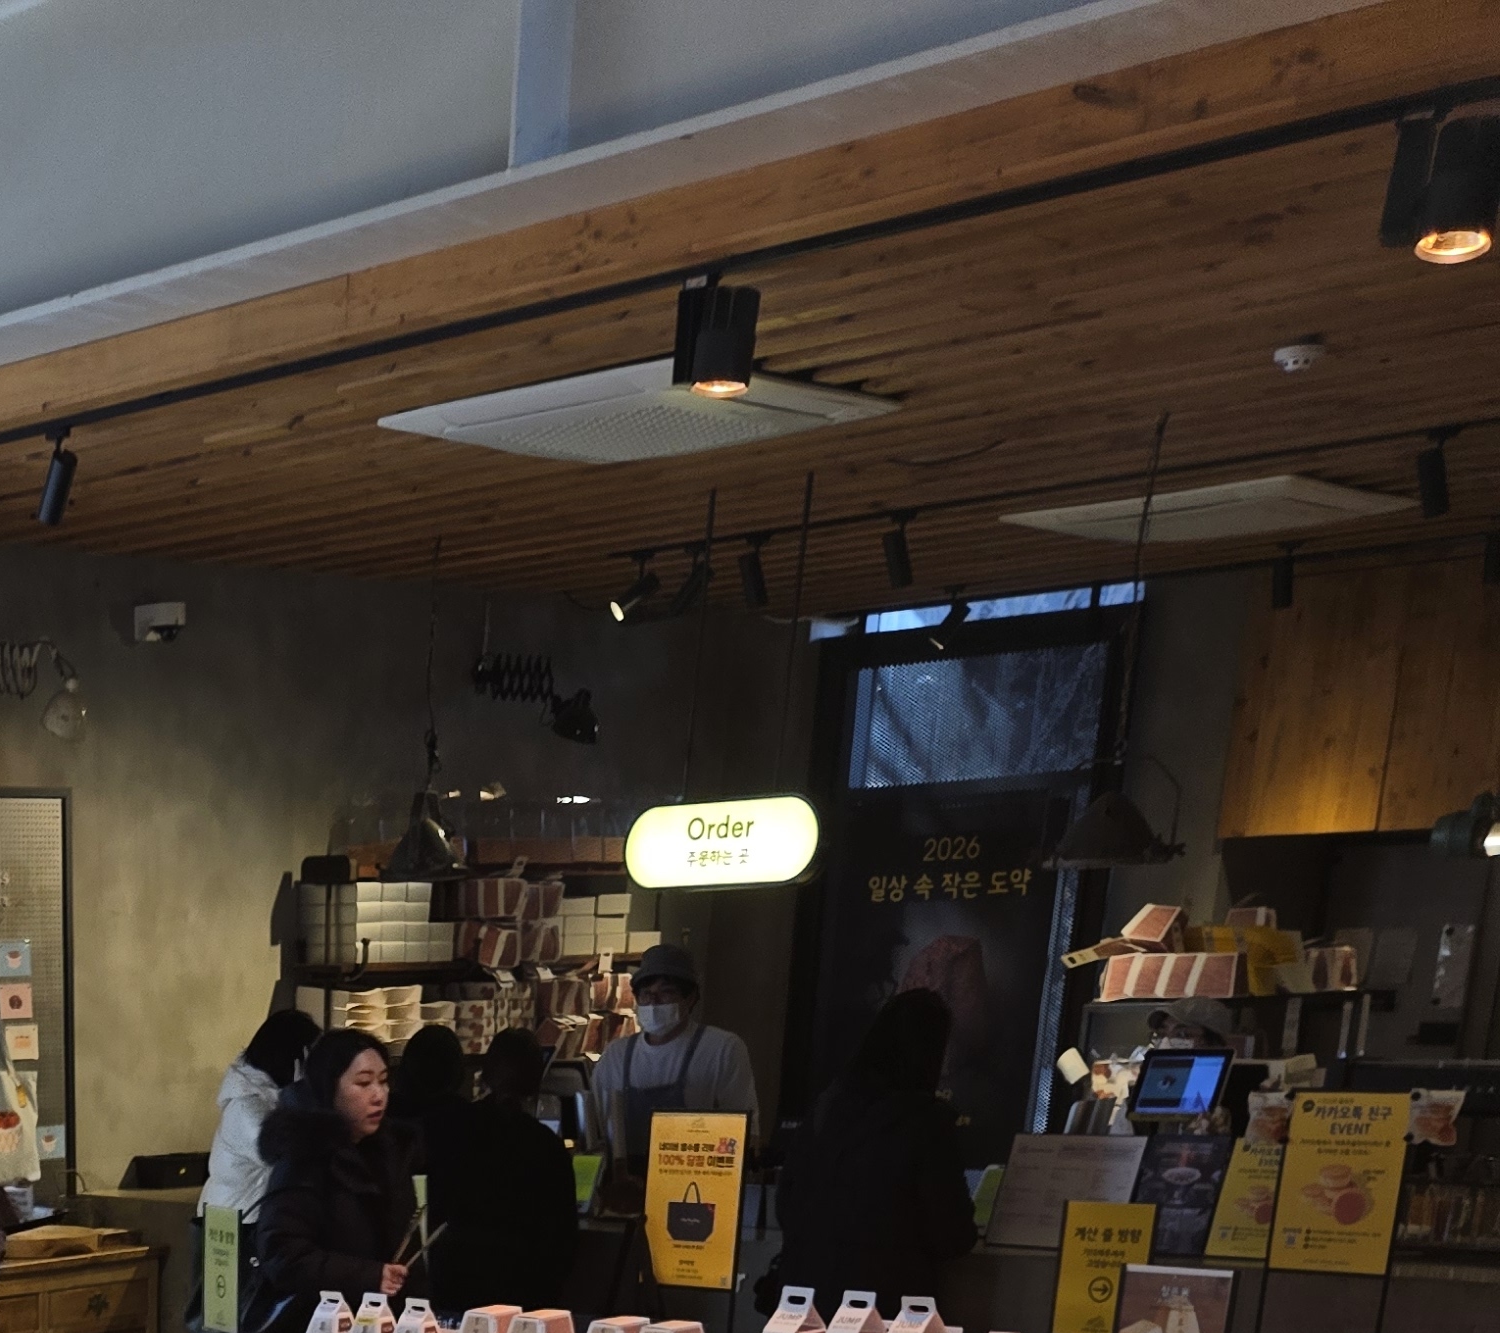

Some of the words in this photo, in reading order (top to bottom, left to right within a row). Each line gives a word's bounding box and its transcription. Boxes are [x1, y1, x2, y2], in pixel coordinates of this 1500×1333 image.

[687, 815, 754, 841] Order
[687, 850, 733, 867] 주문하는
[738, 848, 750, 864] 곳
[922, 836, 981, 862] 2026
[868, 874, 908, 903] 일상
[913, 873, 935, 901] 속
[940, 870, 982, 900] 작은
[987, 868, 1033, 897] 도약
[1329, 1122, 1371, 1136] EVENT
[658, 1153, 685, 1166] 100%
[707, 1155, 735, 1168] 이벤트
[776, 1312, 803, 1321] JUMP
[835, 1315, 862, 1325] JUMP
